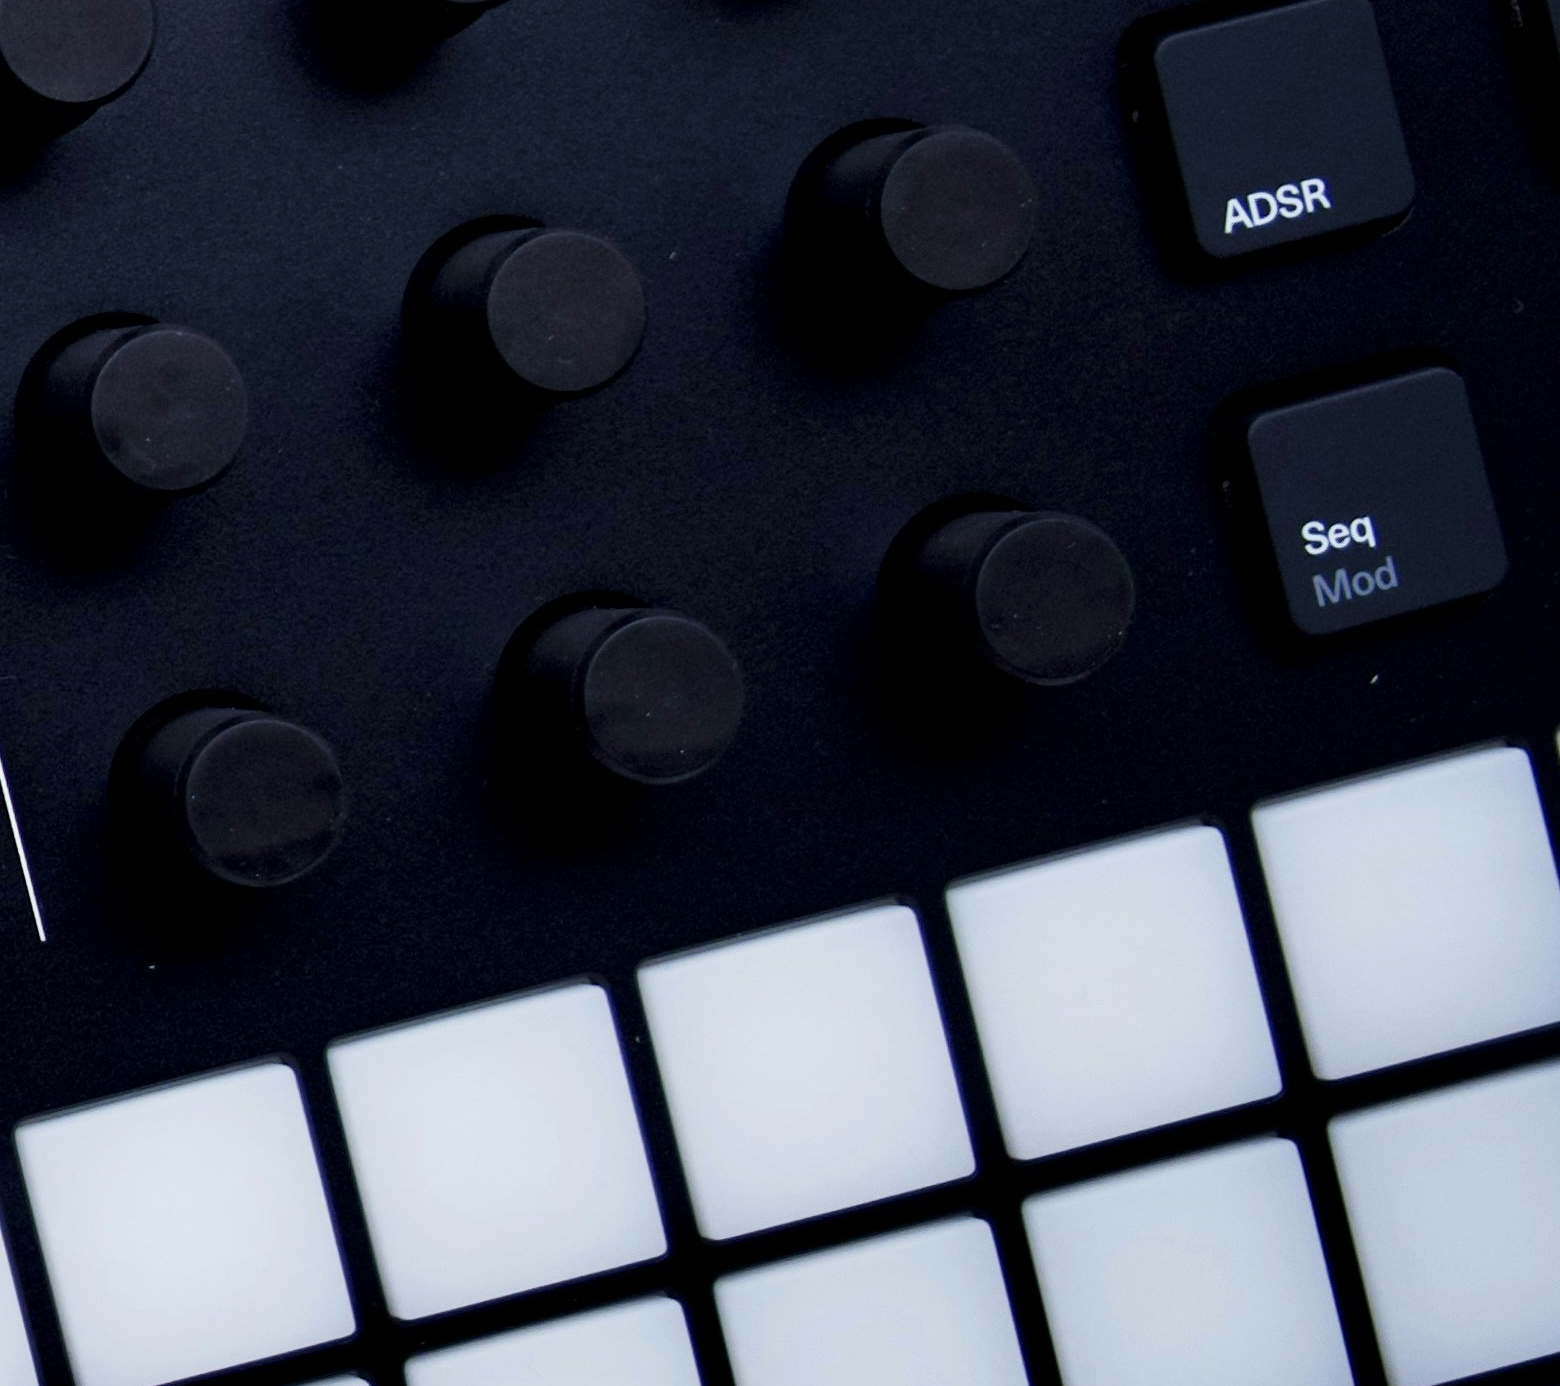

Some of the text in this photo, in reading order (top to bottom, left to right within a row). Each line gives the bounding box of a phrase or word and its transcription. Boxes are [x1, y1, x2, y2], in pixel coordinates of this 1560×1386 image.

[1224, 177, 1331, 234] ADSR
[1300, 515, 1377, 556] Seq
[1311, 554, 1399, 607] Mod
